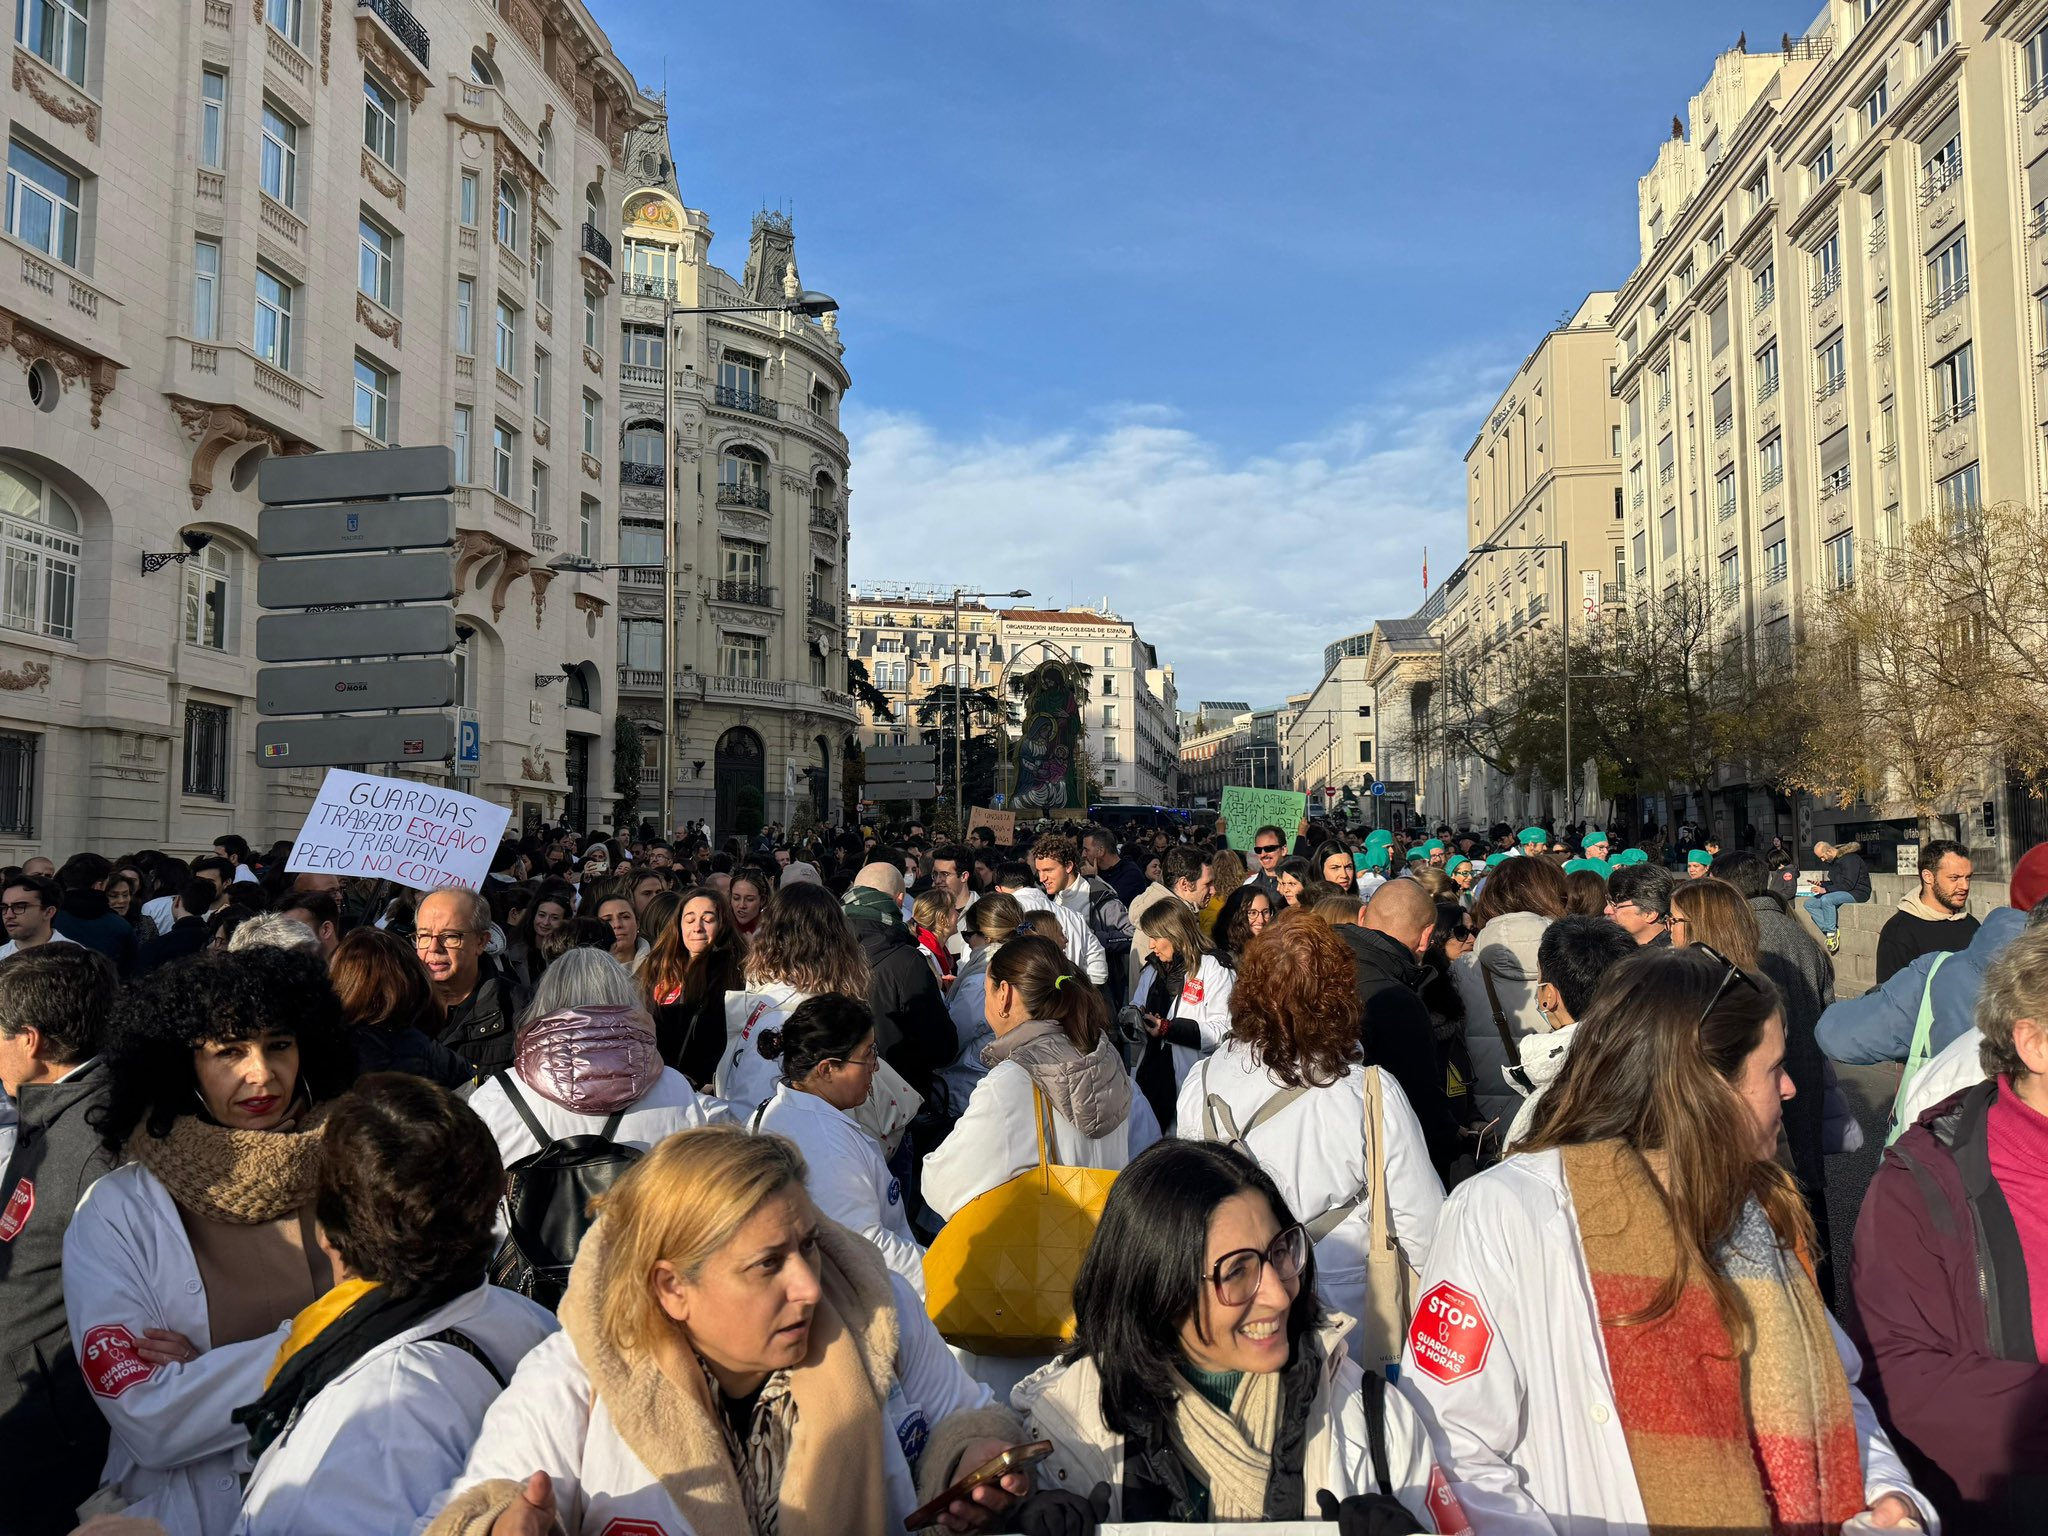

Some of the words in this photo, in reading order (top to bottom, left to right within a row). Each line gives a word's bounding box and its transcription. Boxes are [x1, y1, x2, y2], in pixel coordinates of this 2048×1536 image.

[462, 725, 474, 757] P
[350, 782, 477, 828] GUARDIAS
[320, 803, 402, 832] TRABAJO
[406, 817, 486, 854] ESCLAVO
[293, 843, 354, 869] PERO
[361, 854, 392, 872] NO
[347, 831, 448, 864] TRIBUTAN
[1428, 1296, 1478, 1330] STOP
[1415, 1341, 1426, 1354] 24
[1426, 1347, 1461, 1374] HORAS
[1417, 1331, 1466, 1364] GUARDIAS
[100, 1359, 141, 1384] GUARDI
